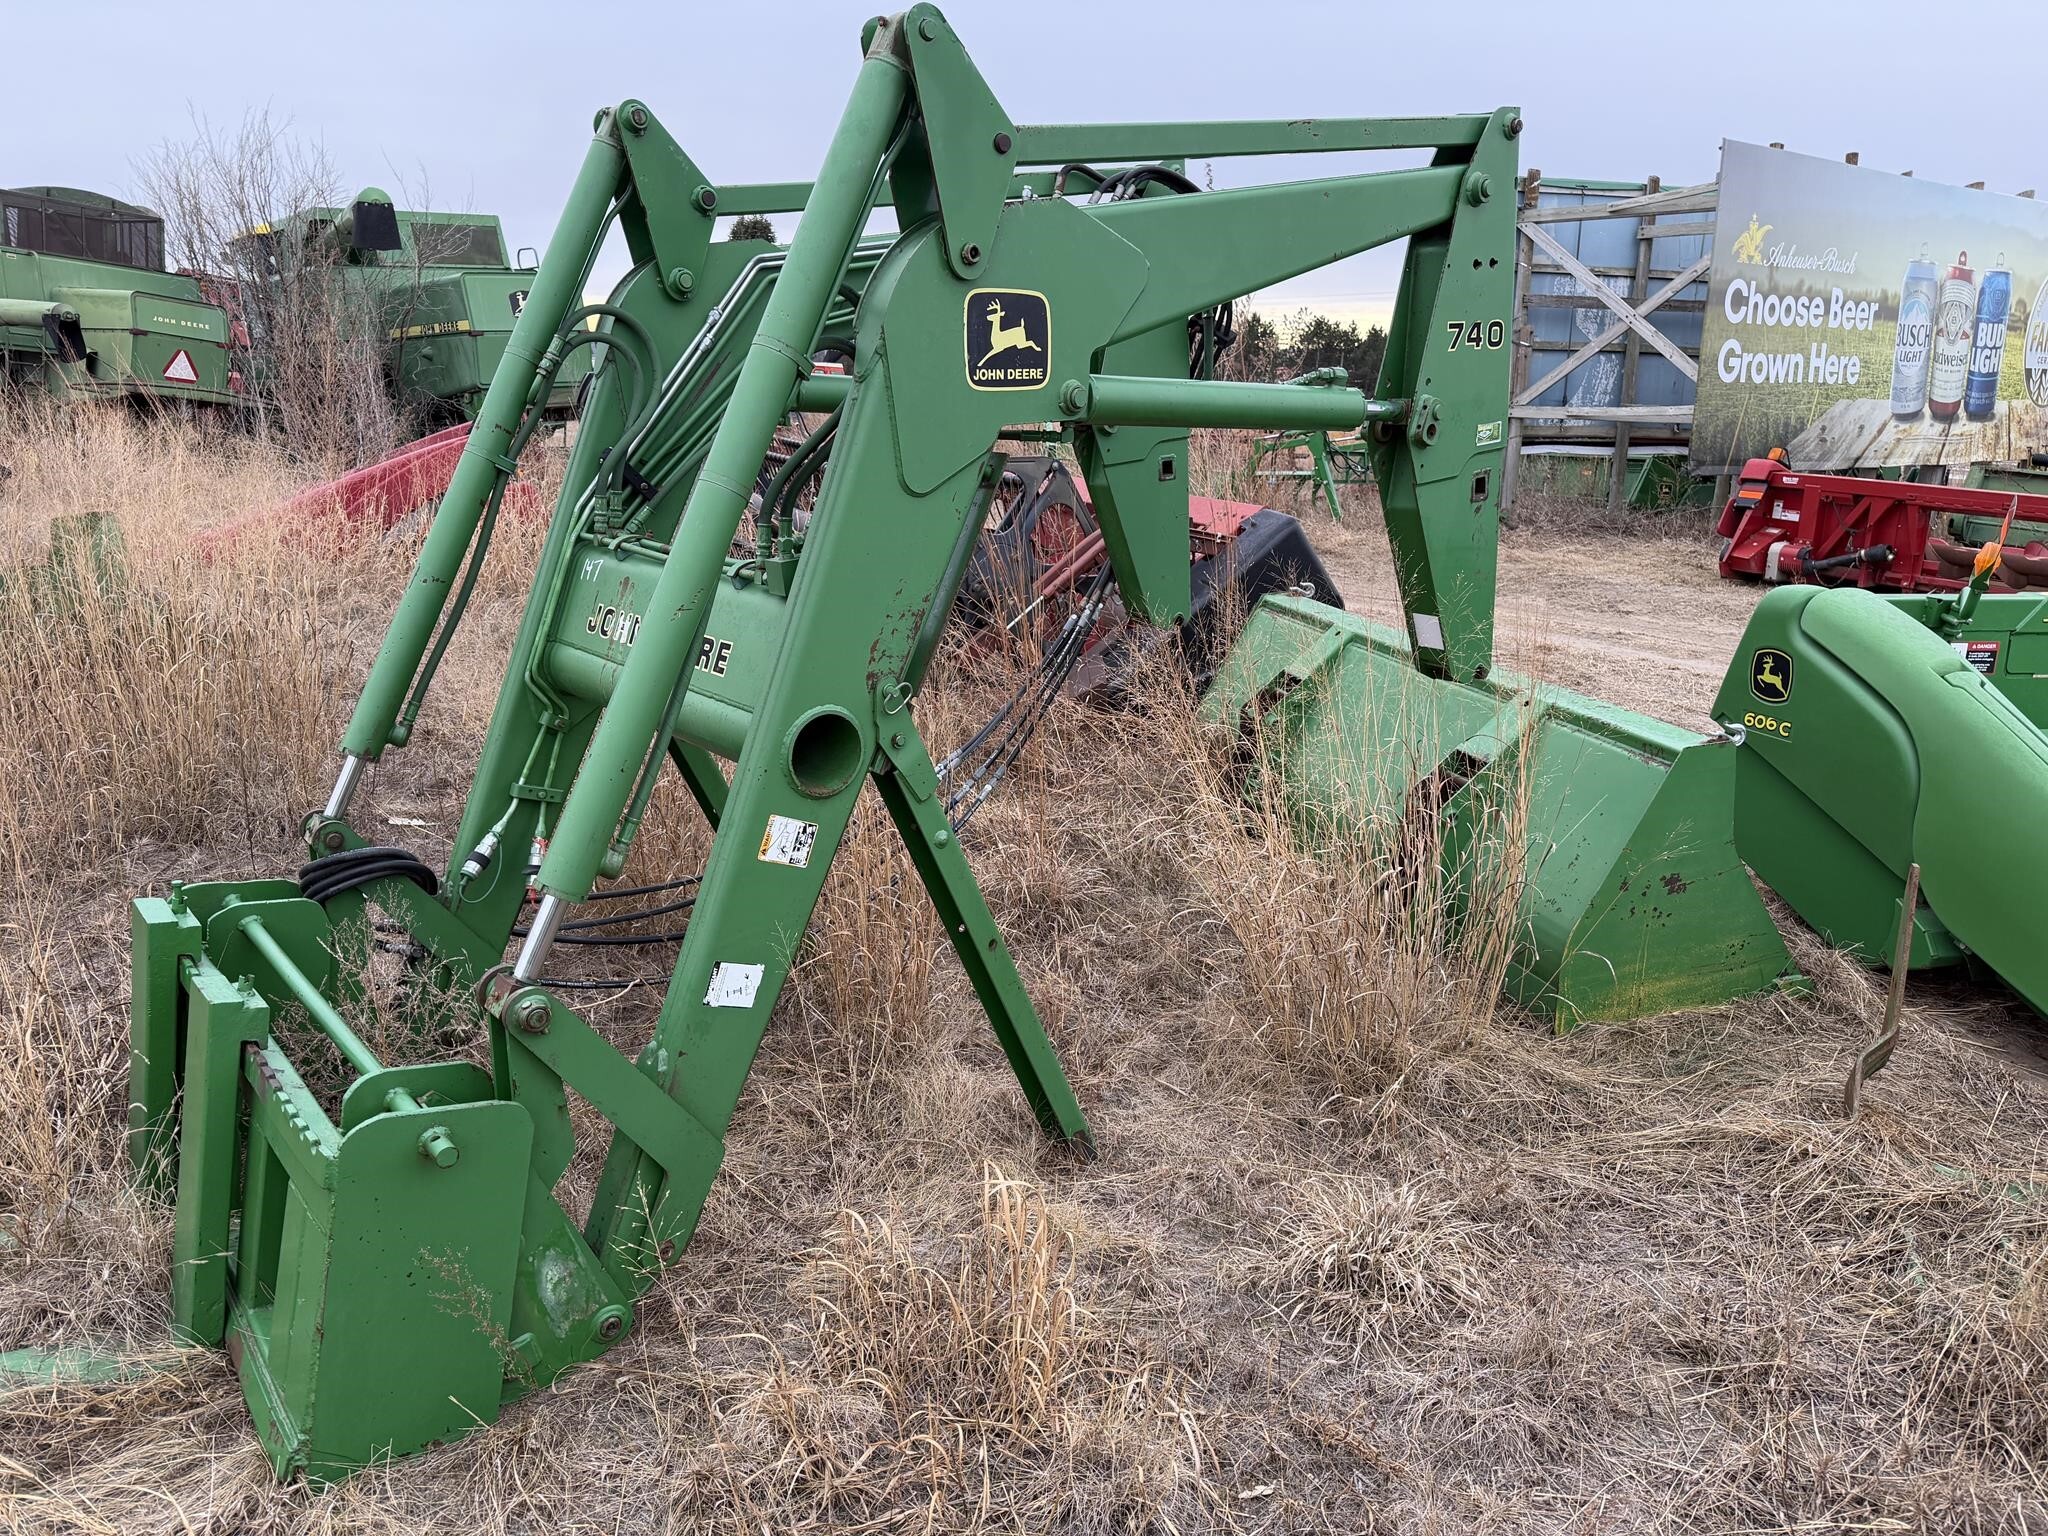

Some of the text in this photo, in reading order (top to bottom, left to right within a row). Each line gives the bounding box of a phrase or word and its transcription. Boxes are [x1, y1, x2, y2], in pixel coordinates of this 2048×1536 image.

[1763, 242, 1858, 274] Anheuser-Busch
[1724, 278, 1879, 331] Choose Beer
[153, 315, 210, 330] JOHN DEERE
[1447, 319, 1505, 352] 740
[1897, 323, 1932, 348] BUSCH
[1977, 322, 2004, 348] BUD
[1717, 338, 1860, 385] Grown Here
[1899, 350, 1922, 363] LIGHT
[1935, 348, 1968, 367] udweise
[1970, 347, 2000, 373] LIGH
[973, 368, 1043, 380] JOHN DEERE
